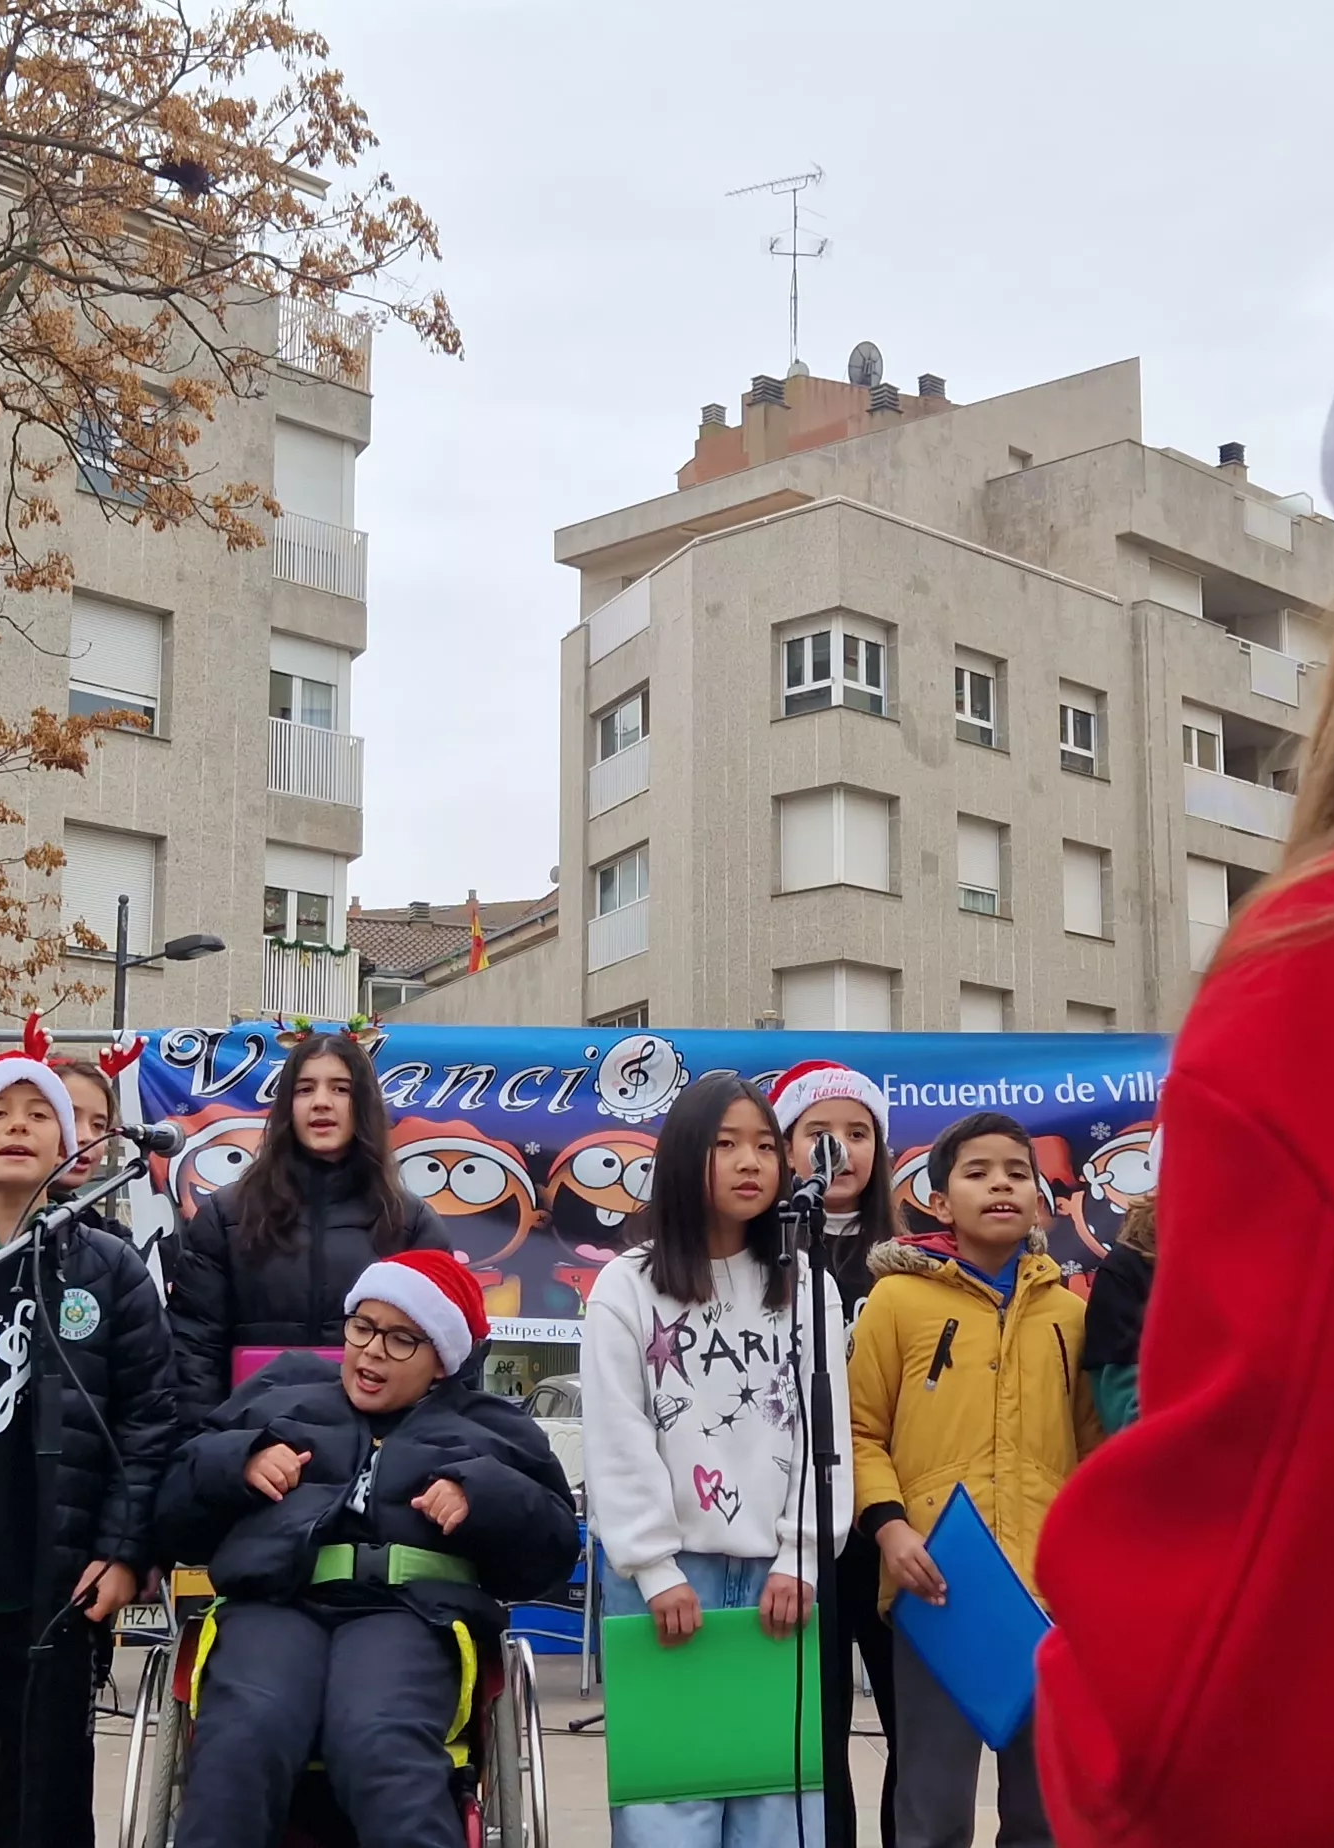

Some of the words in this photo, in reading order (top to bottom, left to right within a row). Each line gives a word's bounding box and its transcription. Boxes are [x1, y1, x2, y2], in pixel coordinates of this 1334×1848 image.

[160, 1028, 600, 1113] Vianci
[882, 1074, 1044, 1107] Encuentro
[1055, 1073, 1095, 1103] de
[488, 1323, 541, 1339] Estirpe
[547, 1325, 566, 1338] de
[571, 1326, 583, 1338] A
[669, 1322, 803, 1376] PARIS
[123, 1606, 159, 1626] HZY
